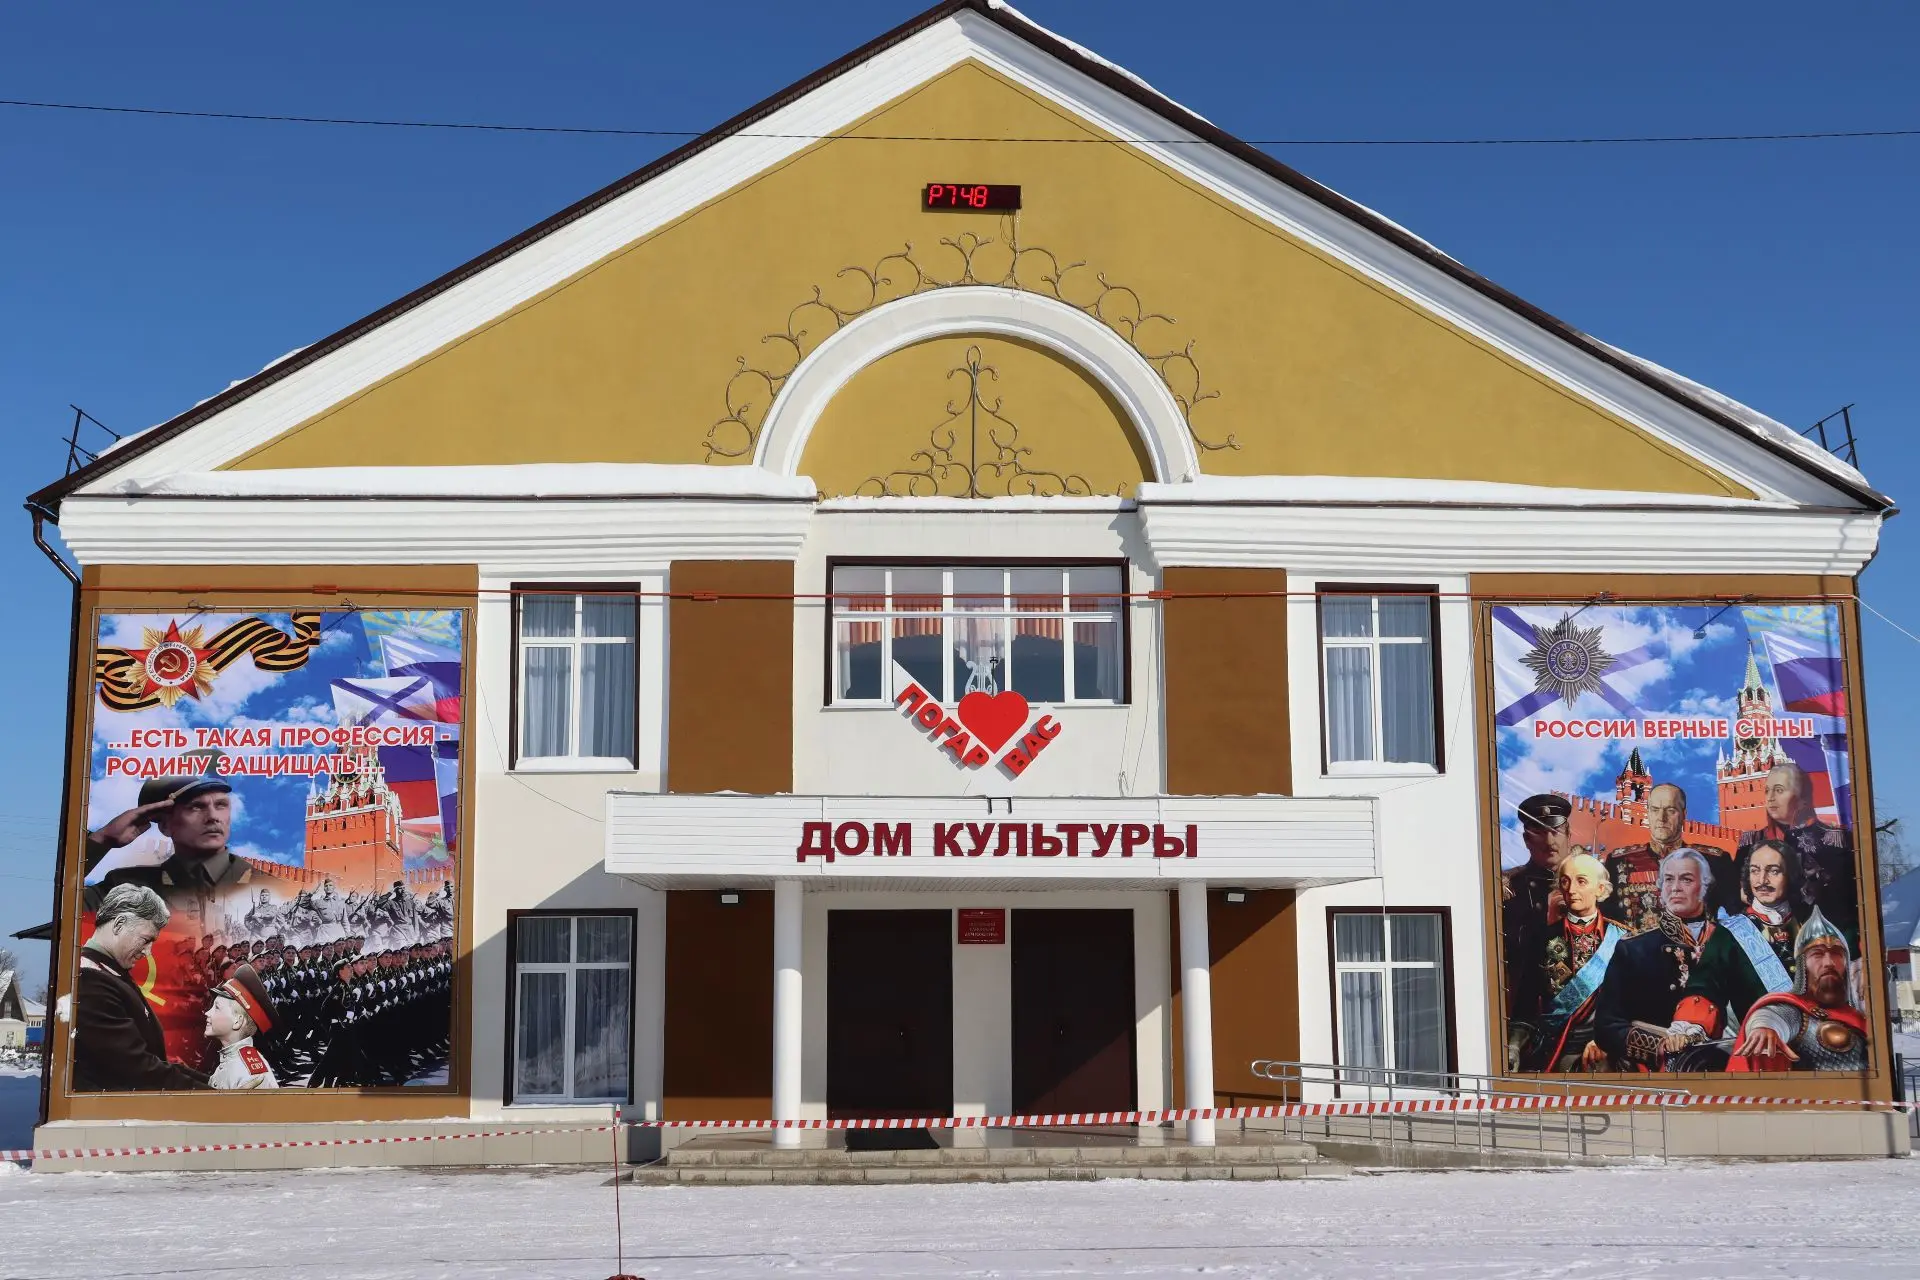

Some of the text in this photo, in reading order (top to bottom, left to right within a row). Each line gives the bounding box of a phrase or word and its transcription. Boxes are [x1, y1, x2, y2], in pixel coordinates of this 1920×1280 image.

[196, 728, 271, 747] ТАКАЯ
[280, 726, 434, 746] ПРОФЕССИЯ
[896, 682, 990, 767] ПОГАР
[1534, 719, 1813, 738] РОССИИ ВЕРНЫЕ СЫНЫ!
[1002, 714, 1062, 776] ВАС
[107, 756, 210, 778] РОДИНУ
[796, 821, 1198, 863] ДОМ КУЛЬТУРЫ
